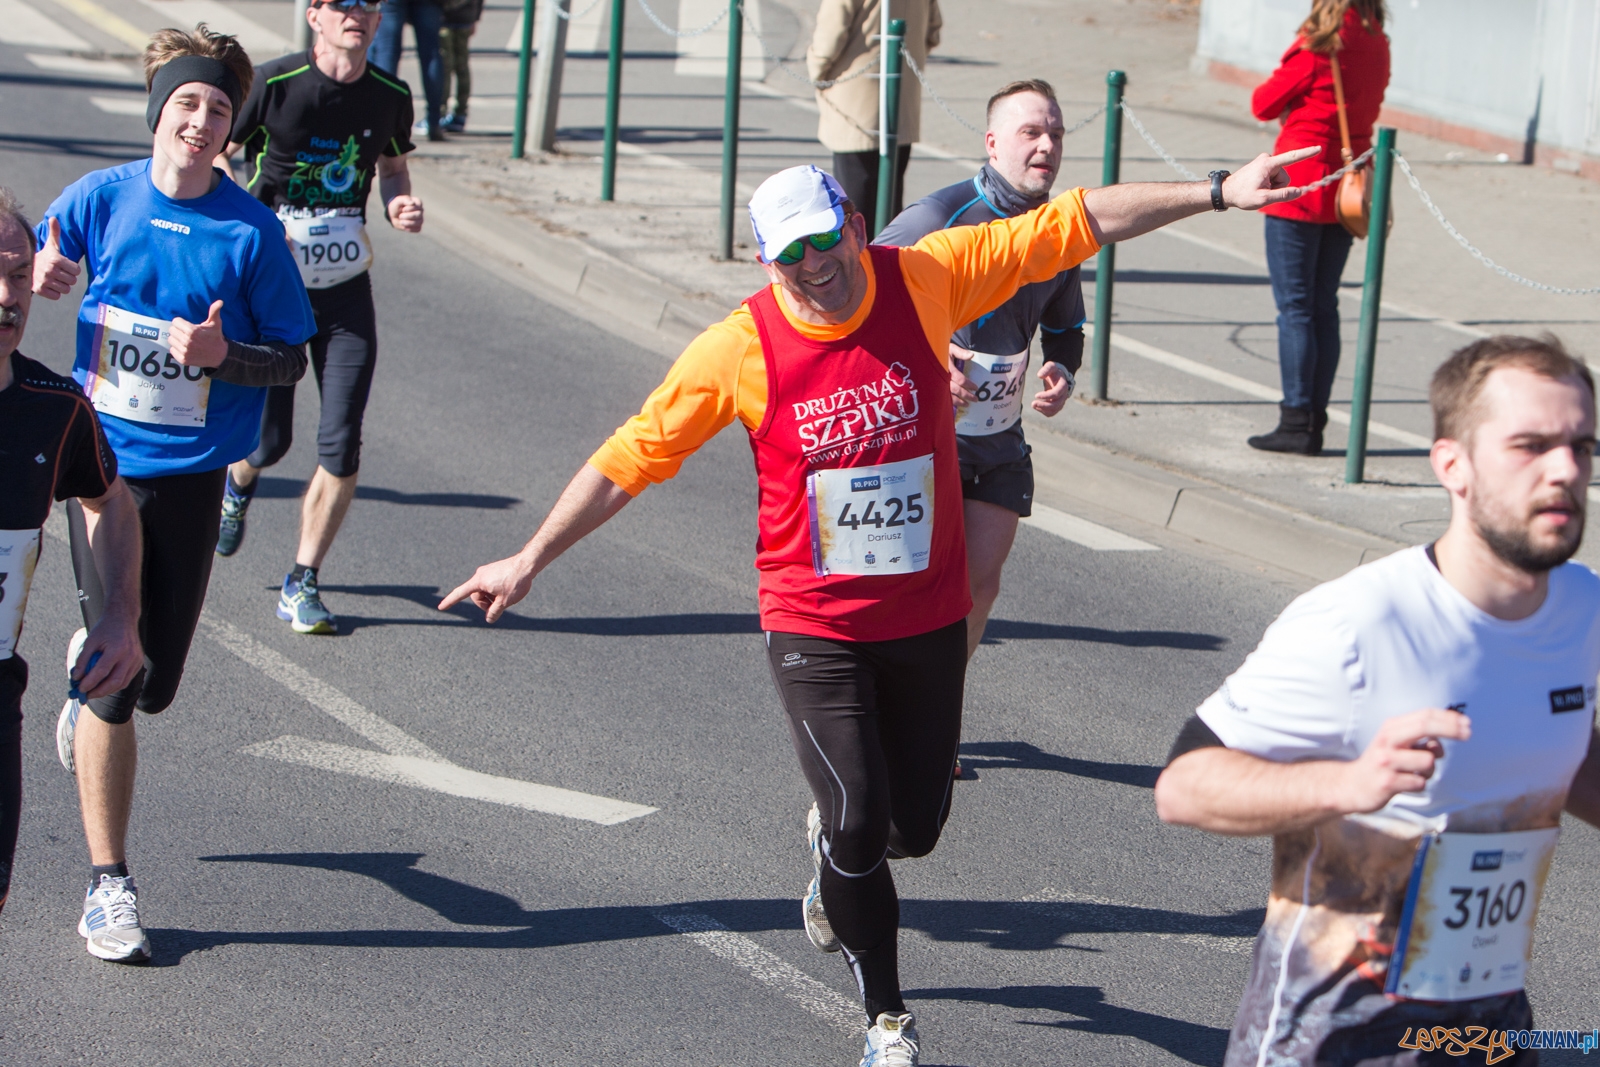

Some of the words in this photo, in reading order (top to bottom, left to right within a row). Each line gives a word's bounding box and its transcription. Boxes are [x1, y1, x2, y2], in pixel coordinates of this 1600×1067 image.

[310, 137, 340, 149] Rada
[300, 240, 360, 266] 1900
[138, 380, 166, 391] Jakub
[792, 379, 896, 421] DRUŻYNA
[798, 389, 919, 453] SZPIKU
[992, 401, 1012, 410] Robert
[807, 425, 918, 465] www.darszpiku.pl
[837, 492, 924, 531] 4425
[867, 532, 902, 542] Dariusz
[1442, 878, 1527, 931] 3160
